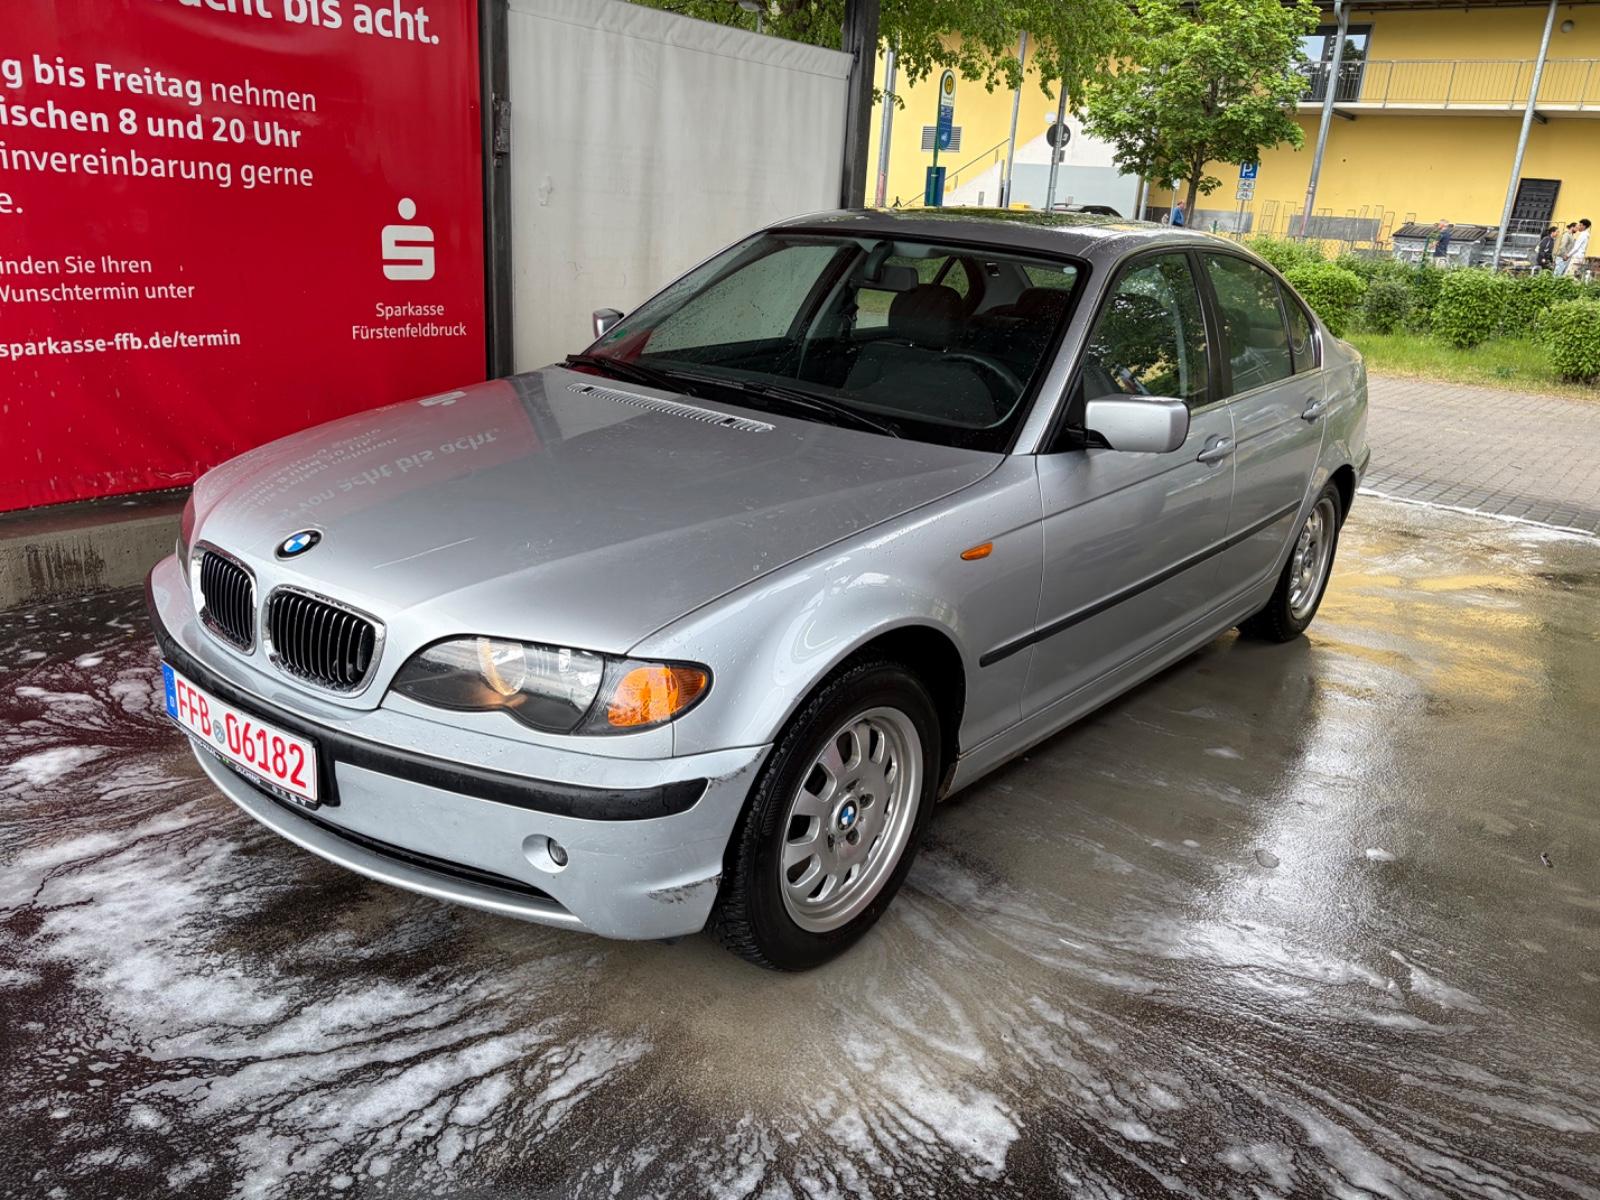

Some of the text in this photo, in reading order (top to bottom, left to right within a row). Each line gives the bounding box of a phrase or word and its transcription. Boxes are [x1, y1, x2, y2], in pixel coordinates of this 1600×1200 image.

[354, 0, 439, 44] acht.
[2, 55, 315, 111] g bis Freitag nehmen
[120, 109, 137, 134] 8
[148, 114, 203, 139] und
[212, 117, 245, 142] 20
[254, 121, 300, 147] Uhr
[0, 140, 312, 188] invereinbarung gerne
[1242, 163, 1253, 177] P
[65, 256, 94, 273] Sie
[102, 256, 151, 272] Ihren
[146, 284, 194, 298] unter
[376, 303, 443, 319] Sparkasse
[0, 330, 240, 360] sparkasse-ffb.de/termin
[353, 324, 465, 338] Fürstenfeldbruck
[176, 678, 212, 736] FFB
[225, 712, 307, 789] 06182
